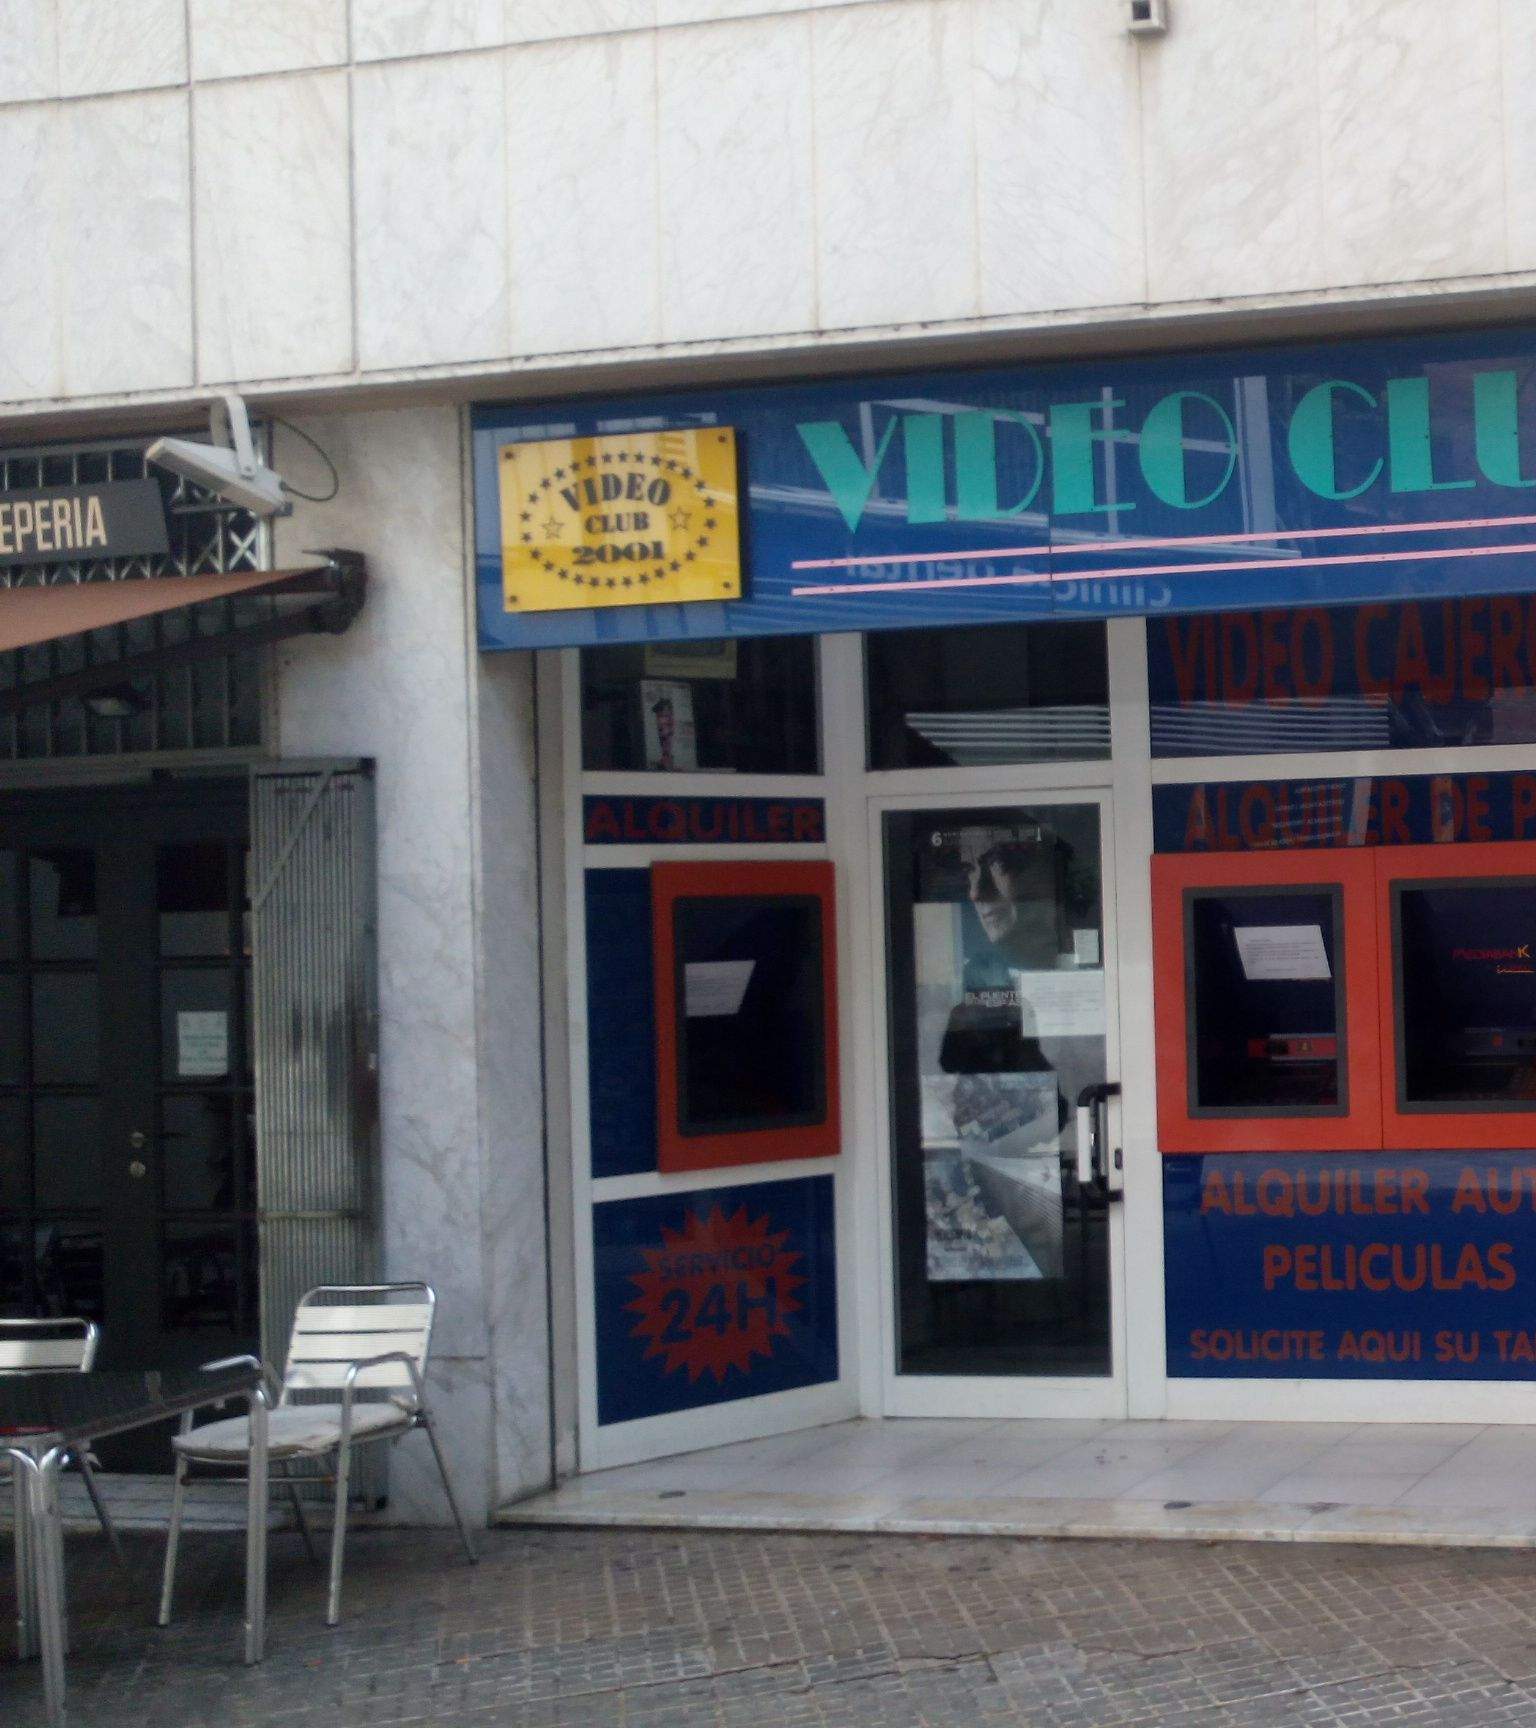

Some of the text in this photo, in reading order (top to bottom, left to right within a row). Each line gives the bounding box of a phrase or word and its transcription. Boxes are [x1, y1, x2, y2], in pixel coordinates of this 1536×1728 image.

[796, 390, 1239, 534] VIDEO
[560, 473, 671, 511] VIDEO
[0, 495, 108, 554] EPERIA
[584, 511, 650, 534] CLUB
[572, 540, 665, 566] 2001
[1165, 604, 1336, 709] VIDEO
[584, 801, 824, 842] ALQUILER
[1185, 778, 1411, 850] ALQUILER
[1431, 774, 1495, 842] DE
[1200, 1167, 1430, 1219] ALQUILER
[659, 1244, 775, 1281] SERVICIO
[1263, 1242, 1516, 1292] PELICULAS
[660, 1275, 777, 1345] 24H
[1190, 1328, 1324, 1362] SOLICITE
[1338, 1330, 1421, 1365] AQUI
[1435, 1330, 1480, 1364] SU
